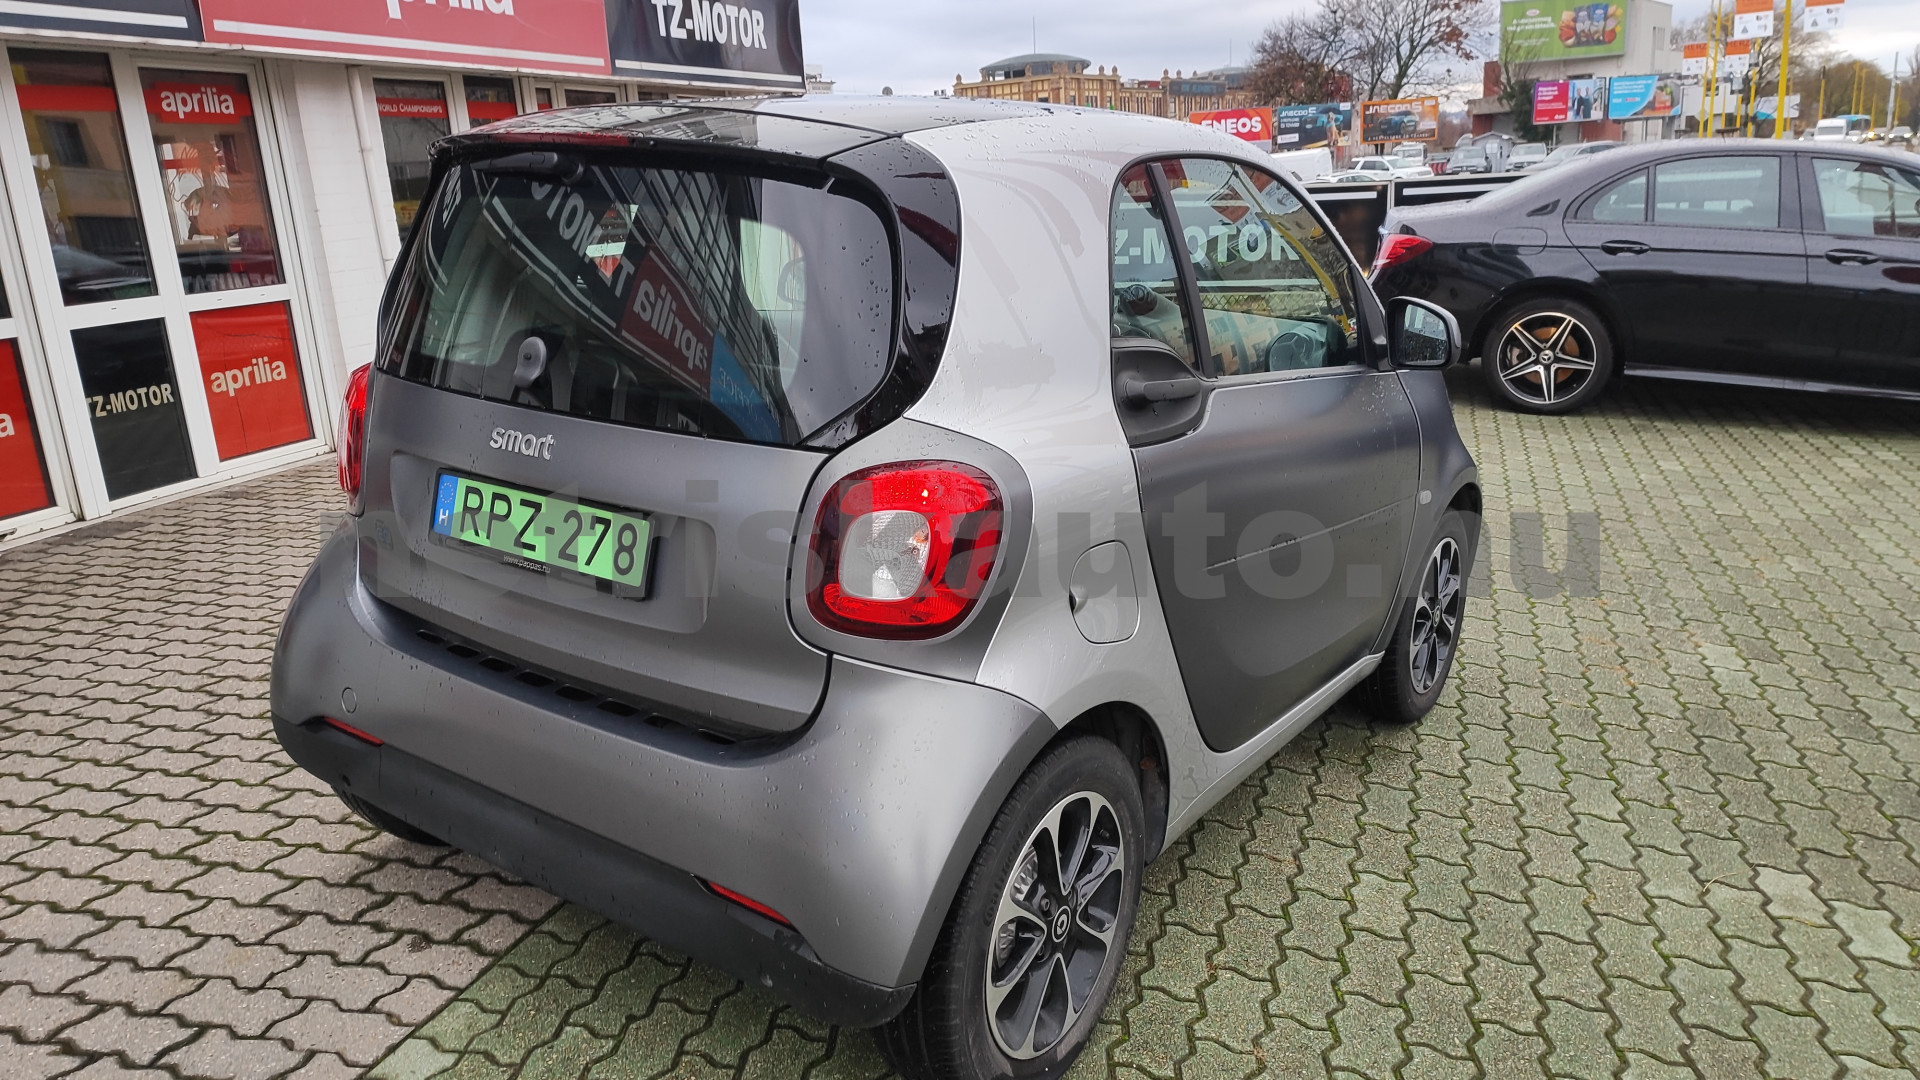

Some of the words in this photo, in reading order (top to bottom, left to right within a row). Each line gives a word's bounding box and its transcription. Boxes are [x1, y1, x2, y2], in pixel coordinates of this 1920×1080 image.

[652, 0, 768, 50] TZ-MOTOR
[160, 87, 235, 119] aprilia
[210, 356, 287, 397] aprilia
[86, 383, 174, 419] TZ-MOTOR
[489, 427, 555, 460] smart
[438, 508, 449, 527] H
[459, 485, 639, 577] RPZ-278
